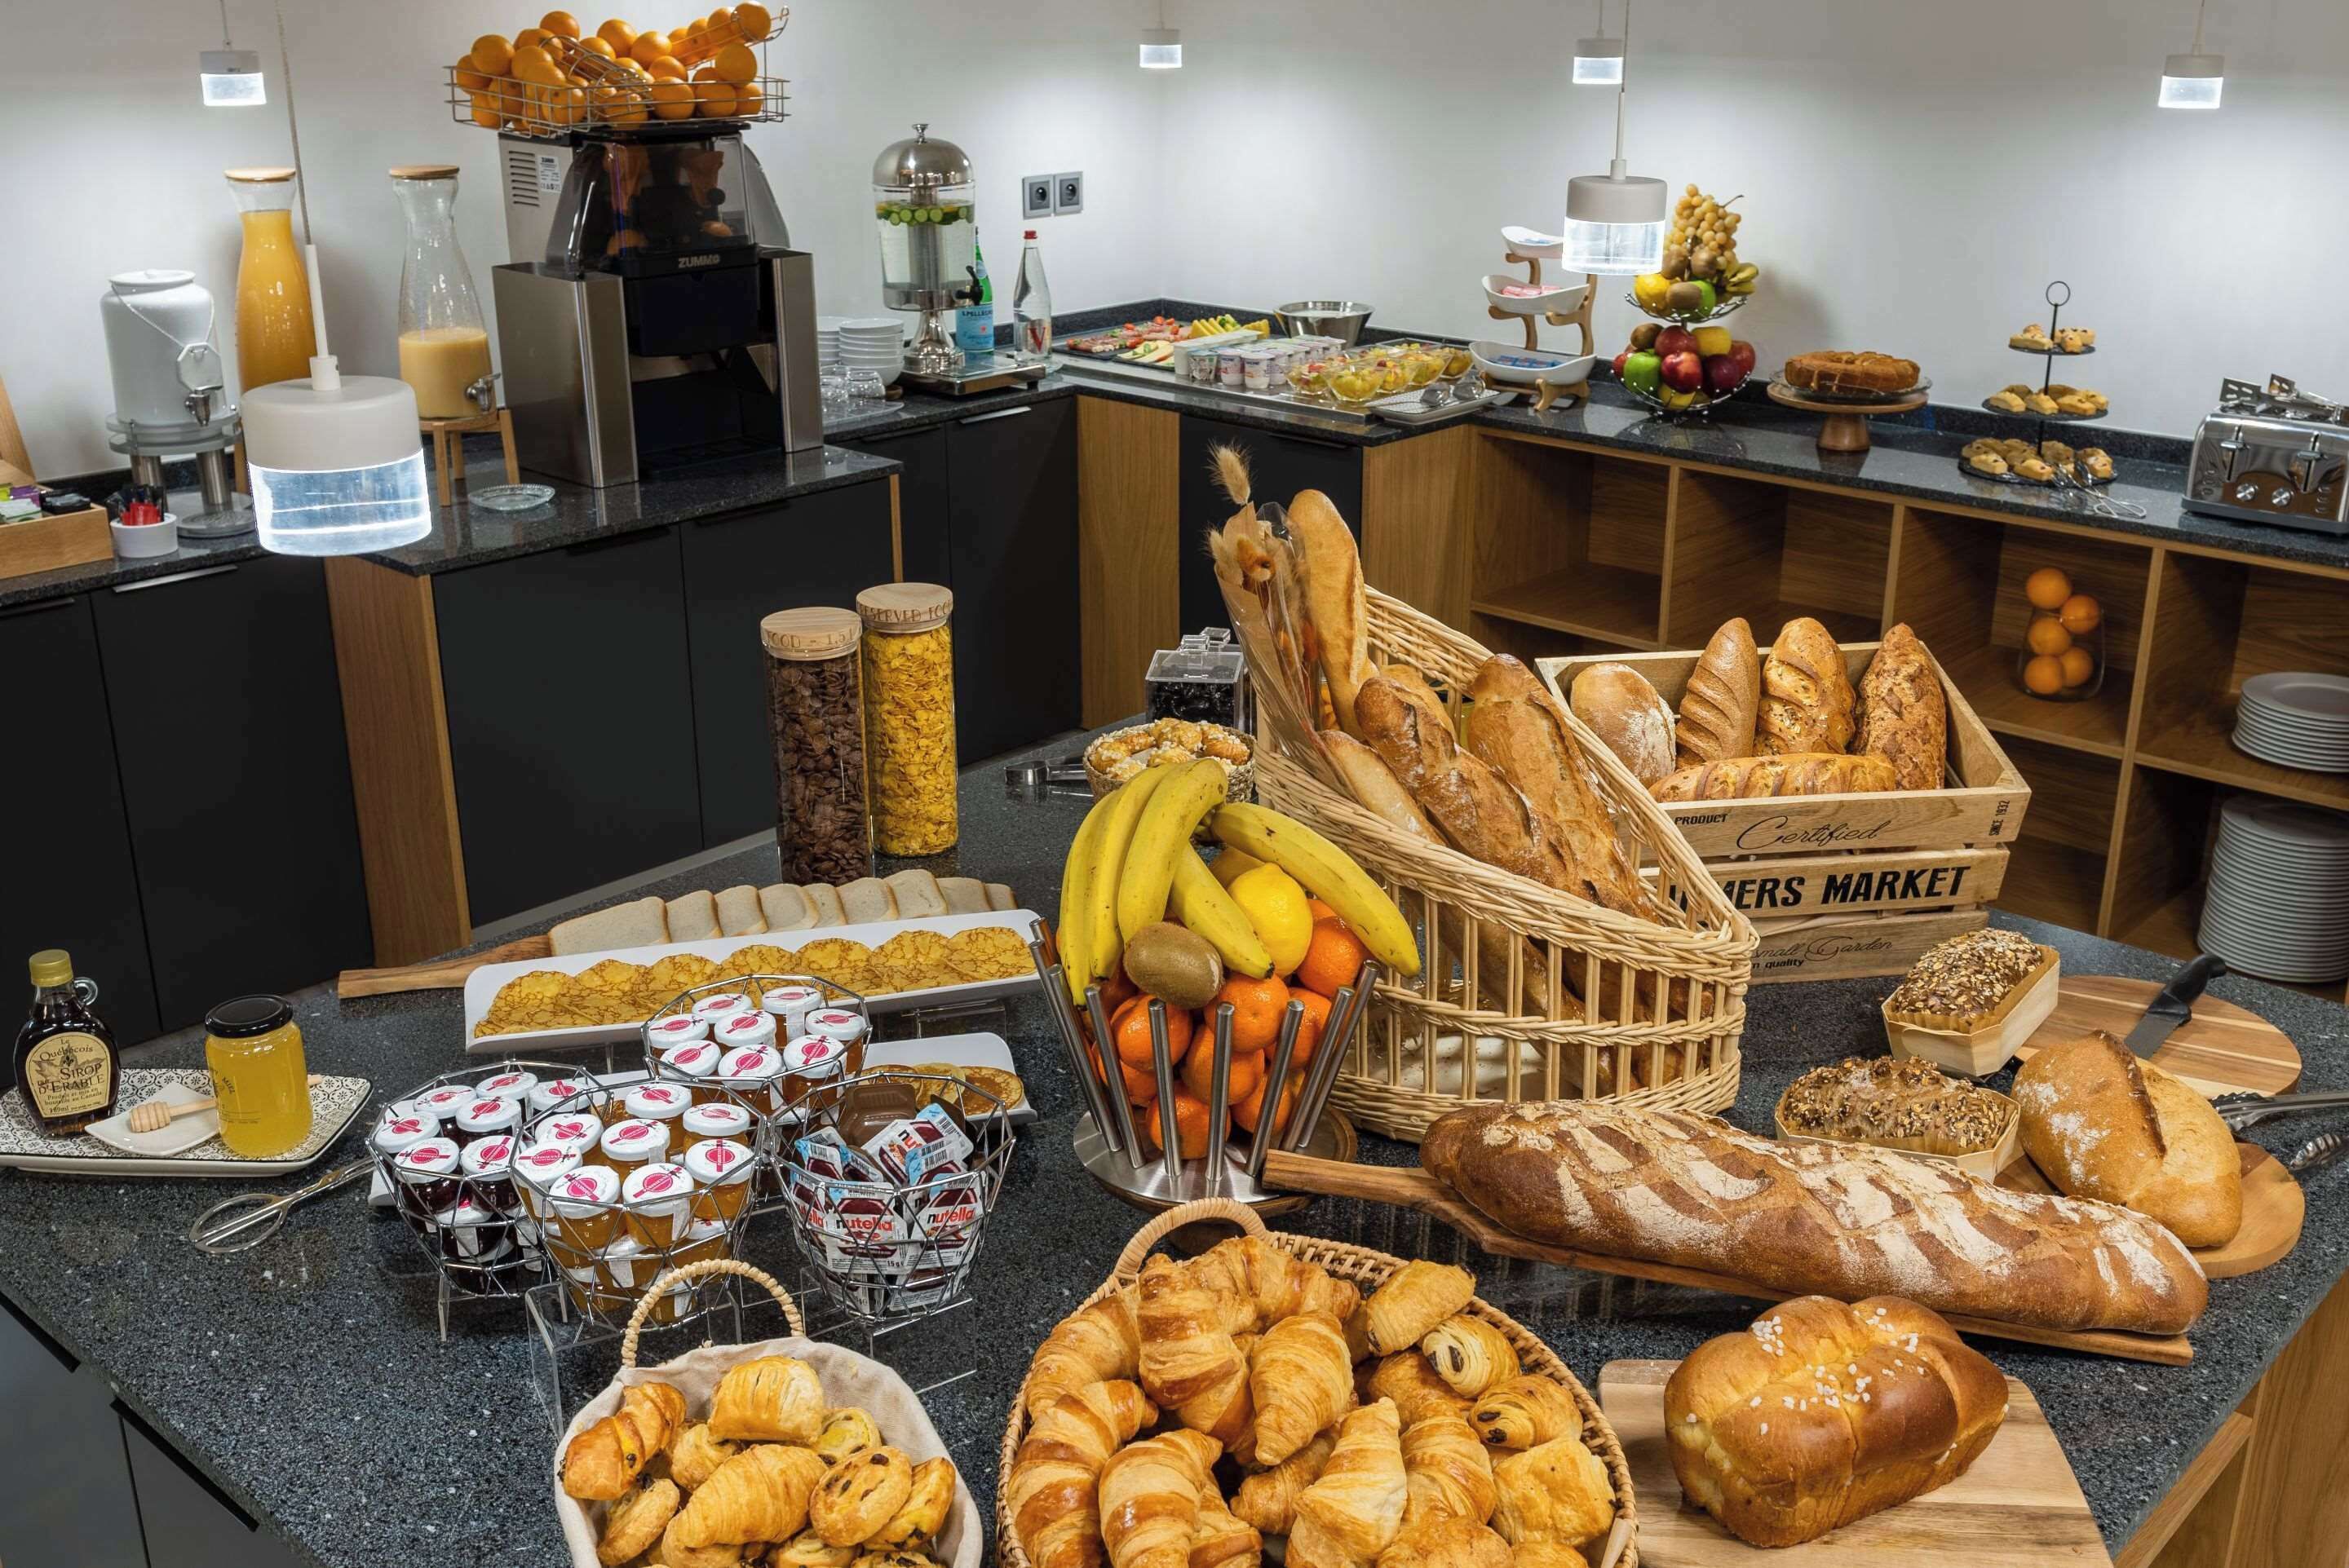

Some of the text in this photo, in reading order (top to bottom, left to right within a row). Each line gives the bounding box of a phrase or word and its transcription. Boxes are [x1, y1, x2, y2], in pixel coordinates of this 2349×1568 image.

[679, 254, 719, 268] ZUMMO
[857, 601, 922, 622] RESERVED
[1674, 814, 1728, 826] PRODUCT
[1988, 800, 2011, 837] SINCE 1932
[1736, 815, 1892, 850] Certified
[1669, 865, 1972, 914] MERS MARKET
[1804, 935, 1893, 962] Garden
[1765, 958, 1805, 970] quality
[927, 1206, 975, 1224] nutella
